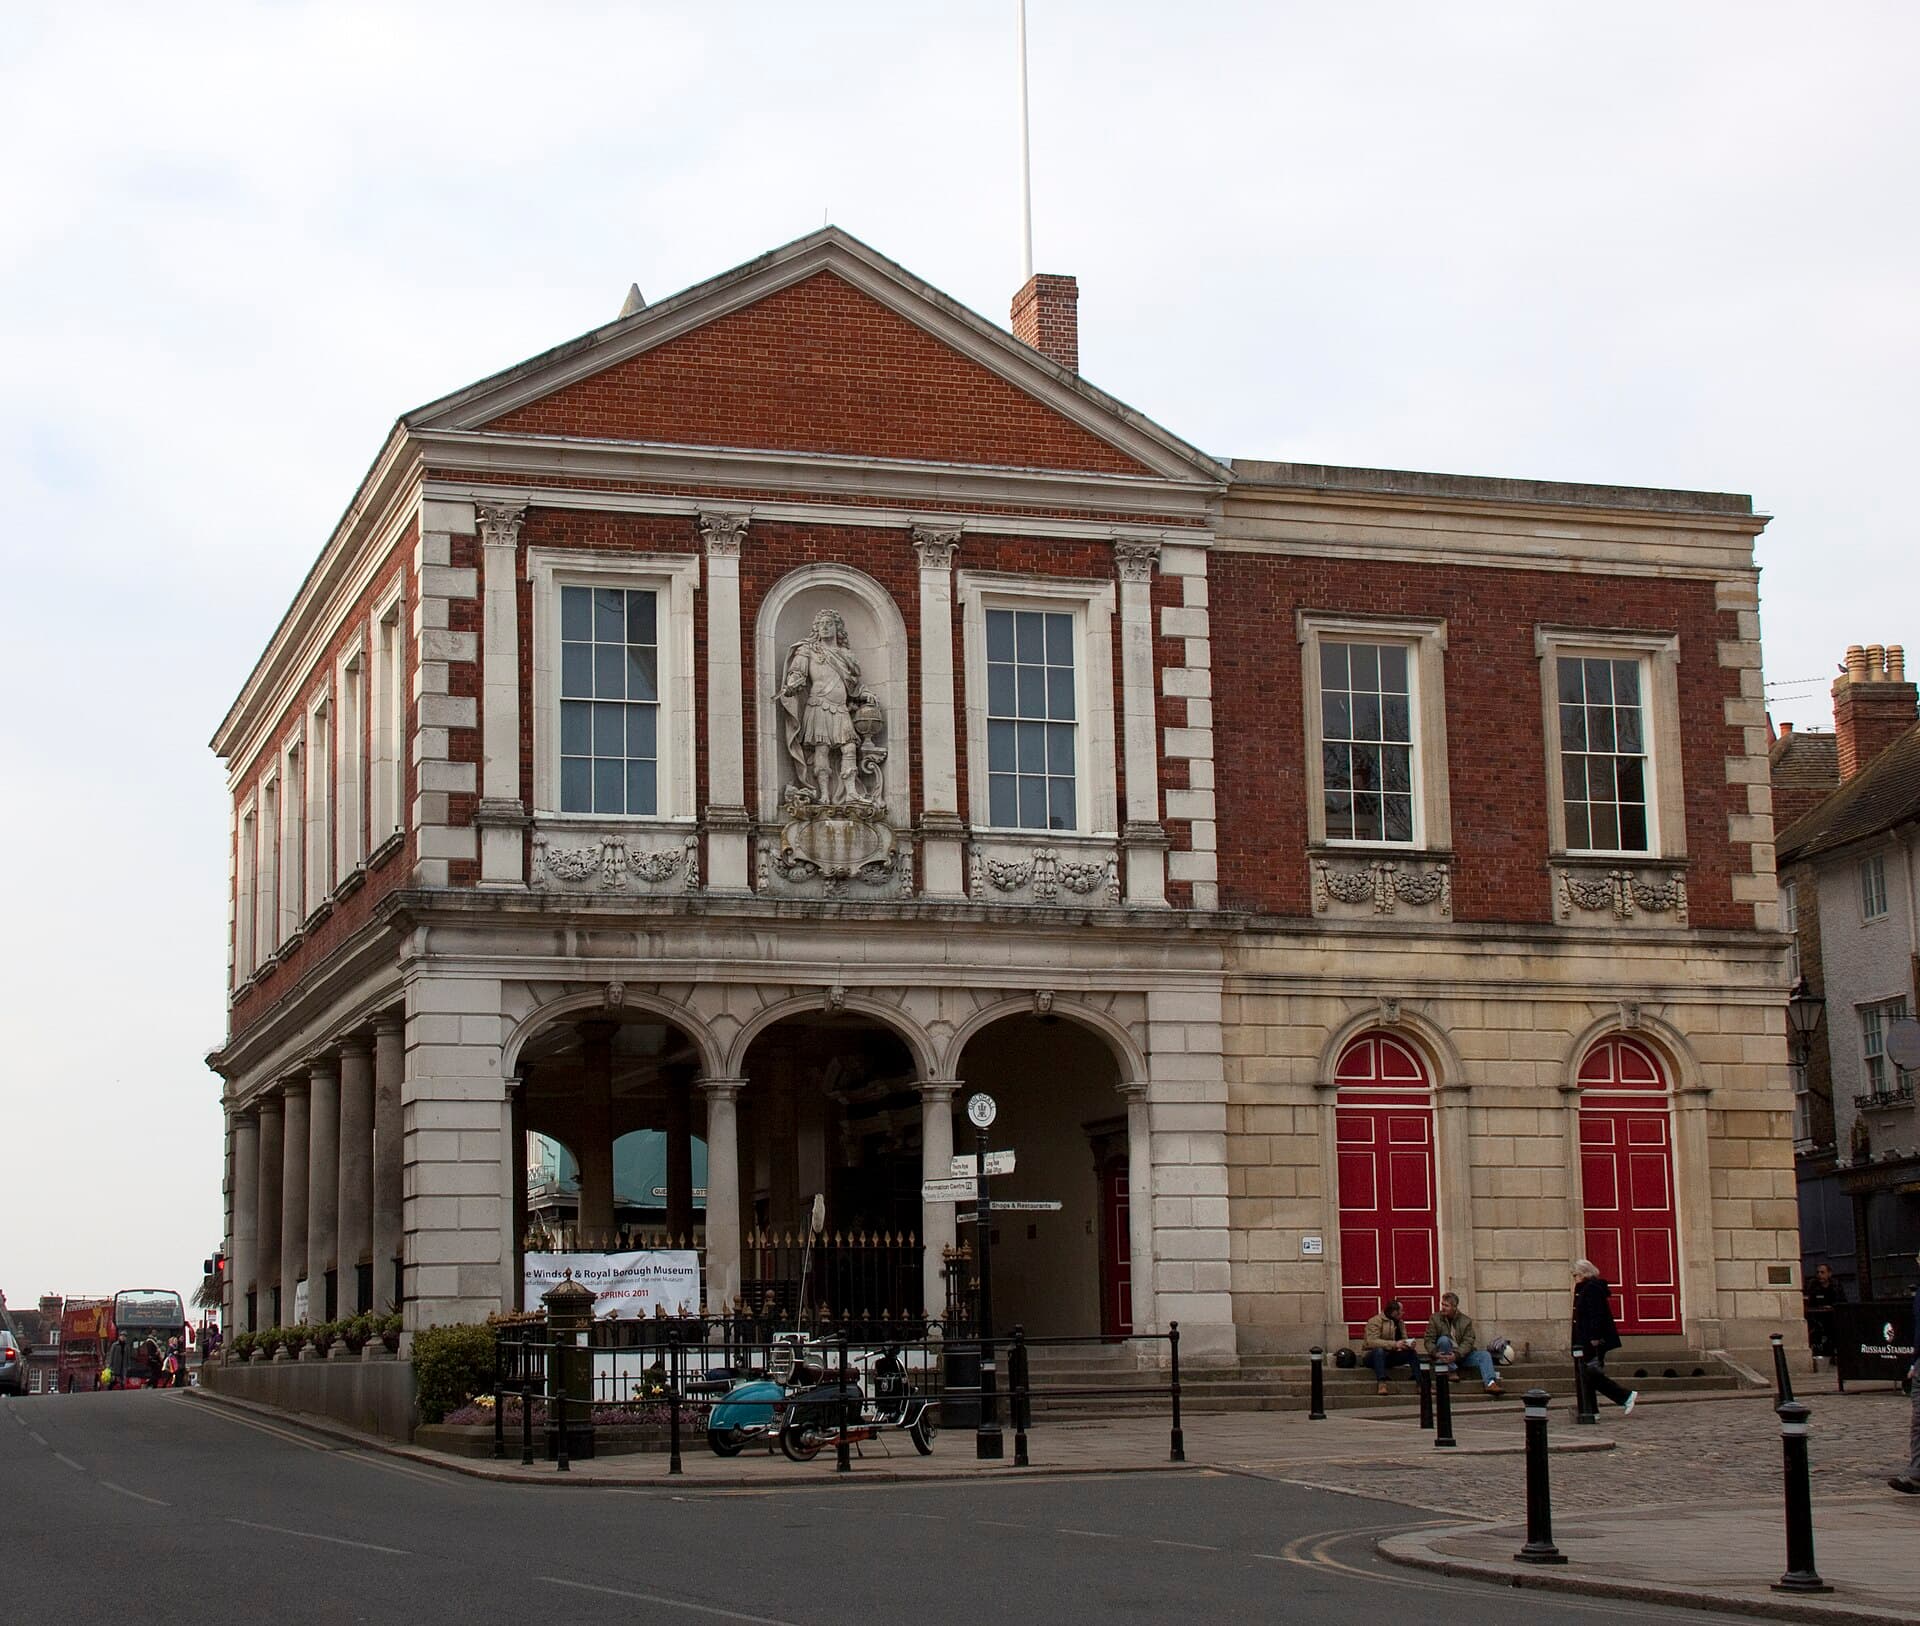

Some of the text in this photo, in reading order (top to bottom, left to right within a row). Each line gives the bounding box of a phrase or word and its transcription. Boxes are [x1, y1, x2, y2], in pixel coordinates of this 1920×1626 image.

[533, 1269, 568, 1278] Windso
[574, 1269, 582, 1278] &
[584, 1268, 611, 1280] Royal
[613, 1266, 651, 1277] Borough
[653, 1265, 693, 1275] Museum
[600, 1290, 630, 1299] SPRING
[632, 1289, 649, 1297] 2011
[1861, 1343, 1914, 1354] RUSSIAN STANDAR
